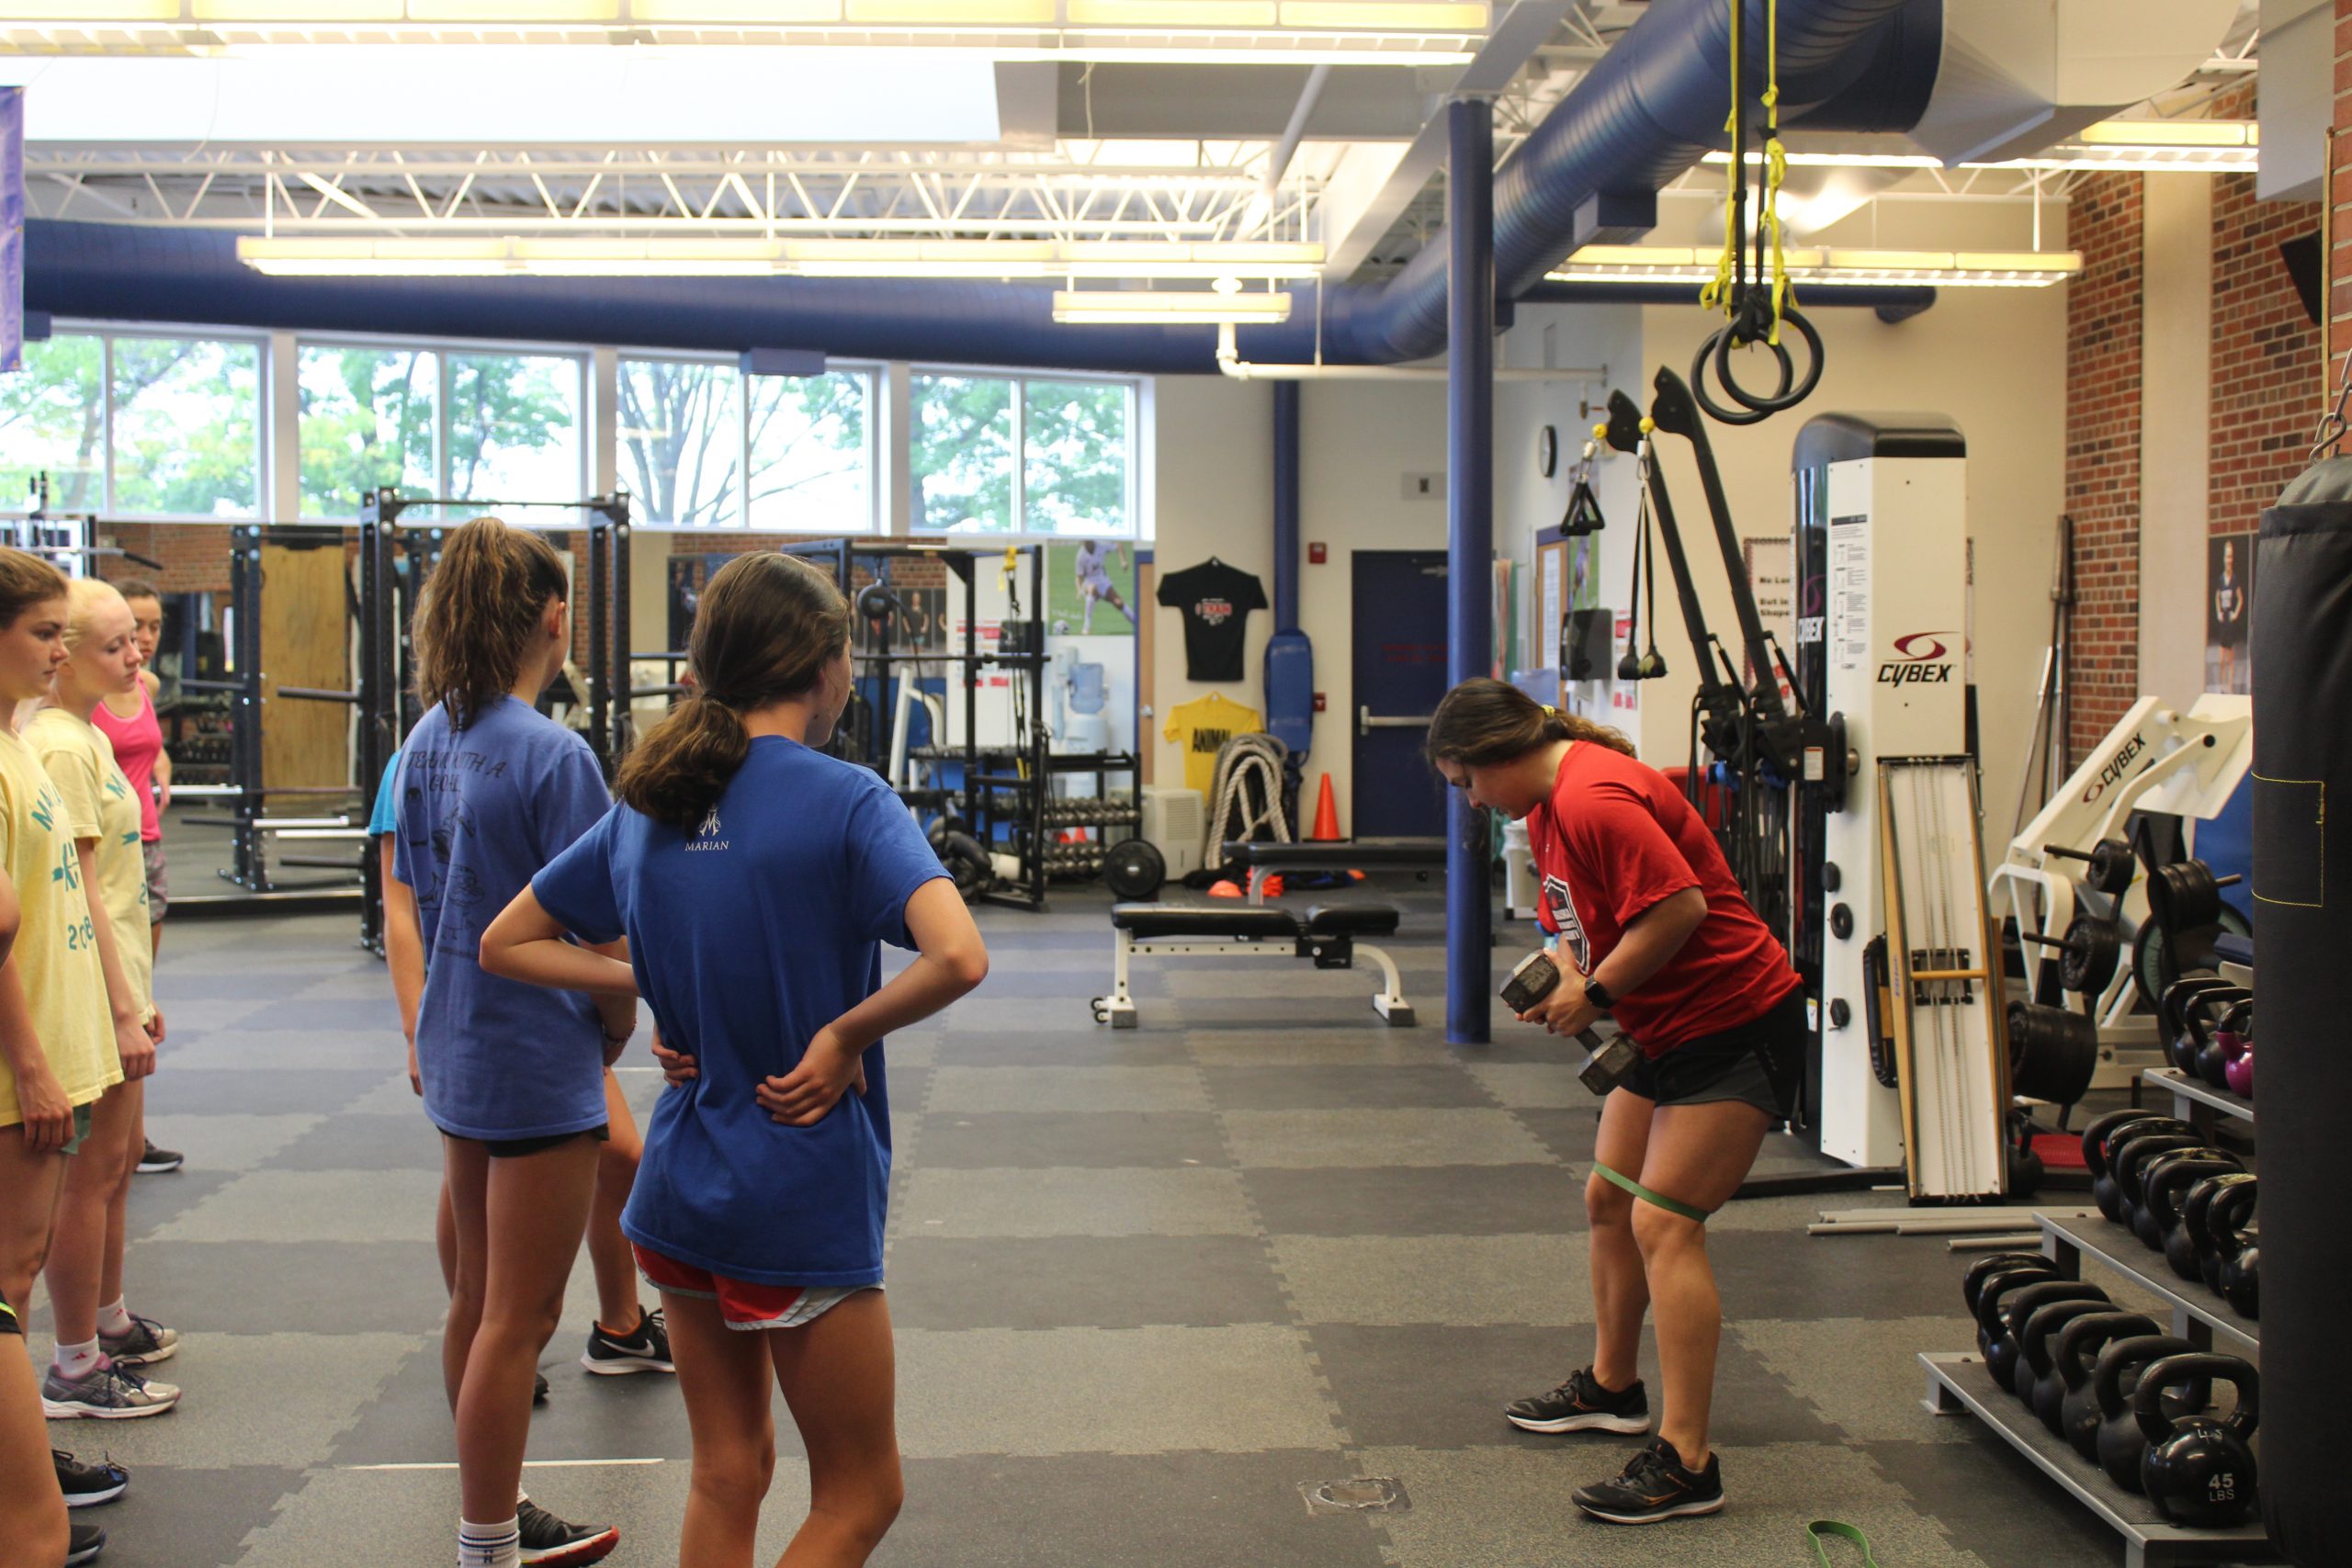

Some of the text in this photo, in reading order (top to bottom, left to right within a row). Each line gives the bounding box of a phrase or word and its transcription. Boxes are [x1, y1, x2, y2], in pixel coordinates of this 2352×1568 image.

[1877, 663, 1952, 688] CYBEX
[2101, 732, 2146, 787] CYBEX
[684, 840, 729, 852] MARIAN
[2208, 1472, 2234, 1489] 45
[2209, 1489, 2235, 1502] LBS
